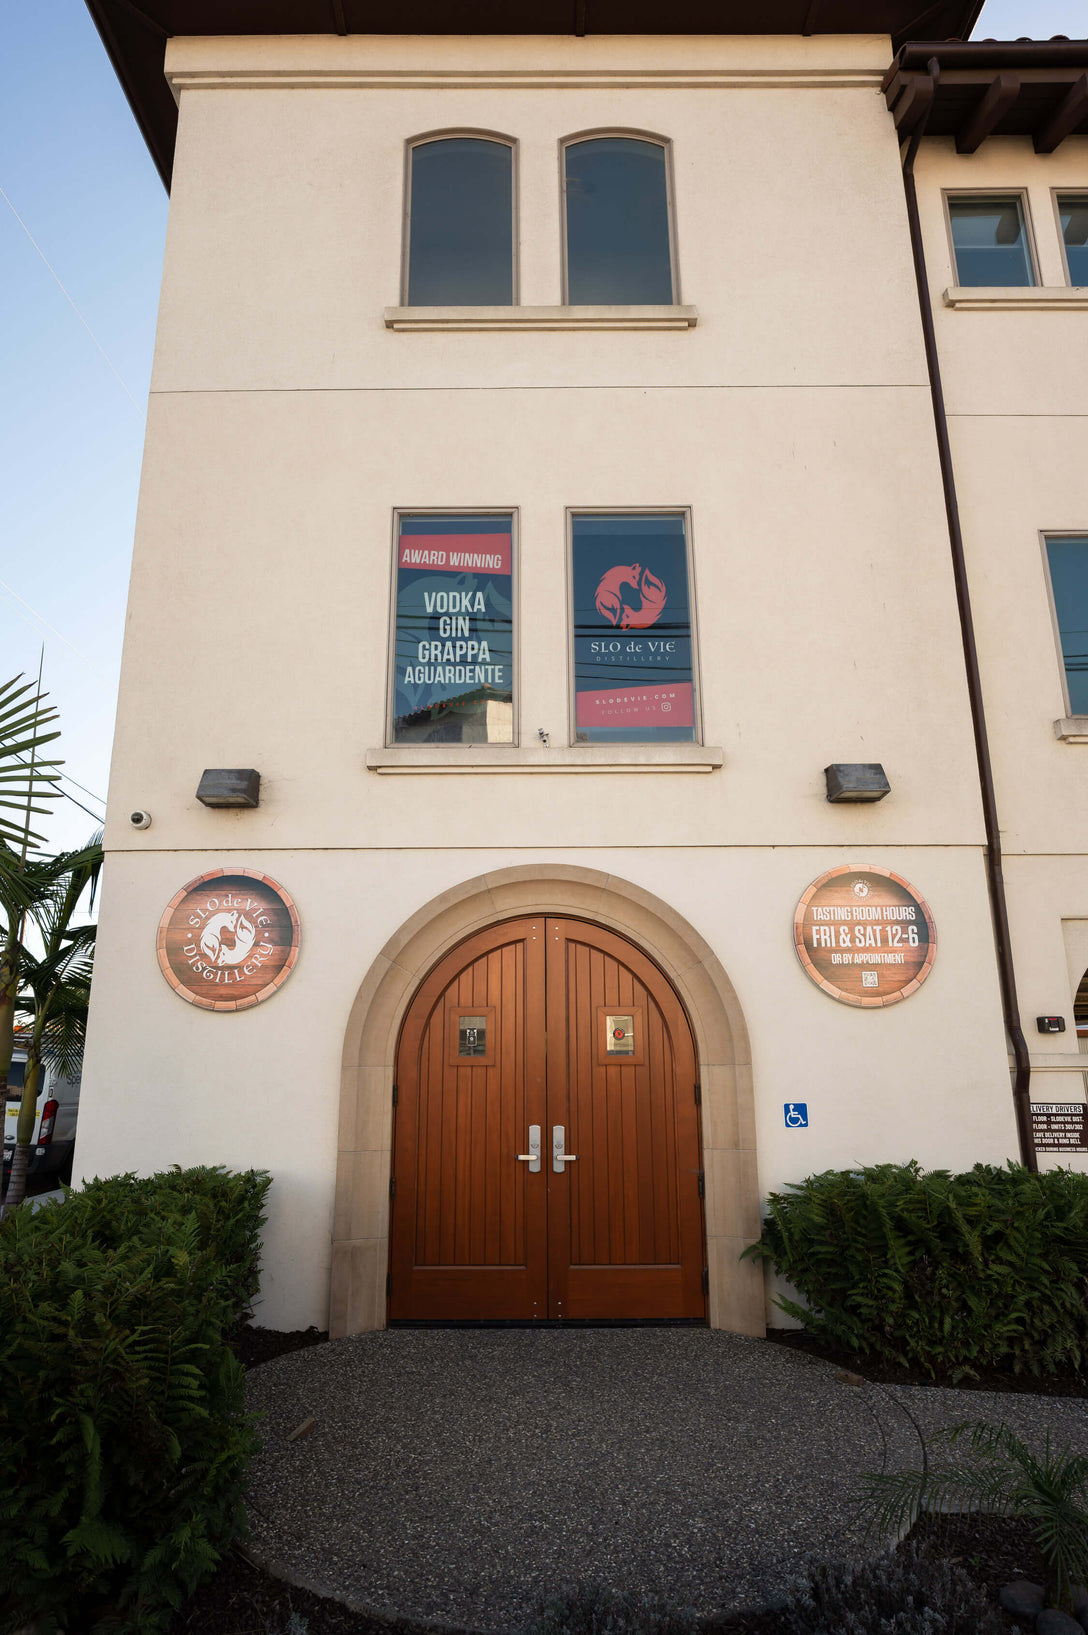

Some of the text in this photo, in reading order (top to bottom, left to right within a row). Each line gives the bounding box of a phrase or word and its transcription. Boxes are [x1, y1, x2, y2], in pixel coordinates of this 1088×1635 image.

[402, 549, 502, 568] AWARD WINNING
[424, 592, 486, 613] VODKA
[439, 616, 470, 637] GIN
[418, 641, 491, 662] GRAPPA
[591, 641, 676, 652] SLO de VIE
[404, 665, 504, 684] AGUARDENTE
[595, 693, 676, 705] SLODEVIE.COM
[188, 893, 272, 928] SLO de VIE
[812, 906, 916, 921] TASTING ROOM HOURS
[812, 925, 919, 947] FRI & SAT 12-6
[183, 941, 274, 984] DISTILLERY
[831, 953, 905, 964] OR BY APPOINTMENT
